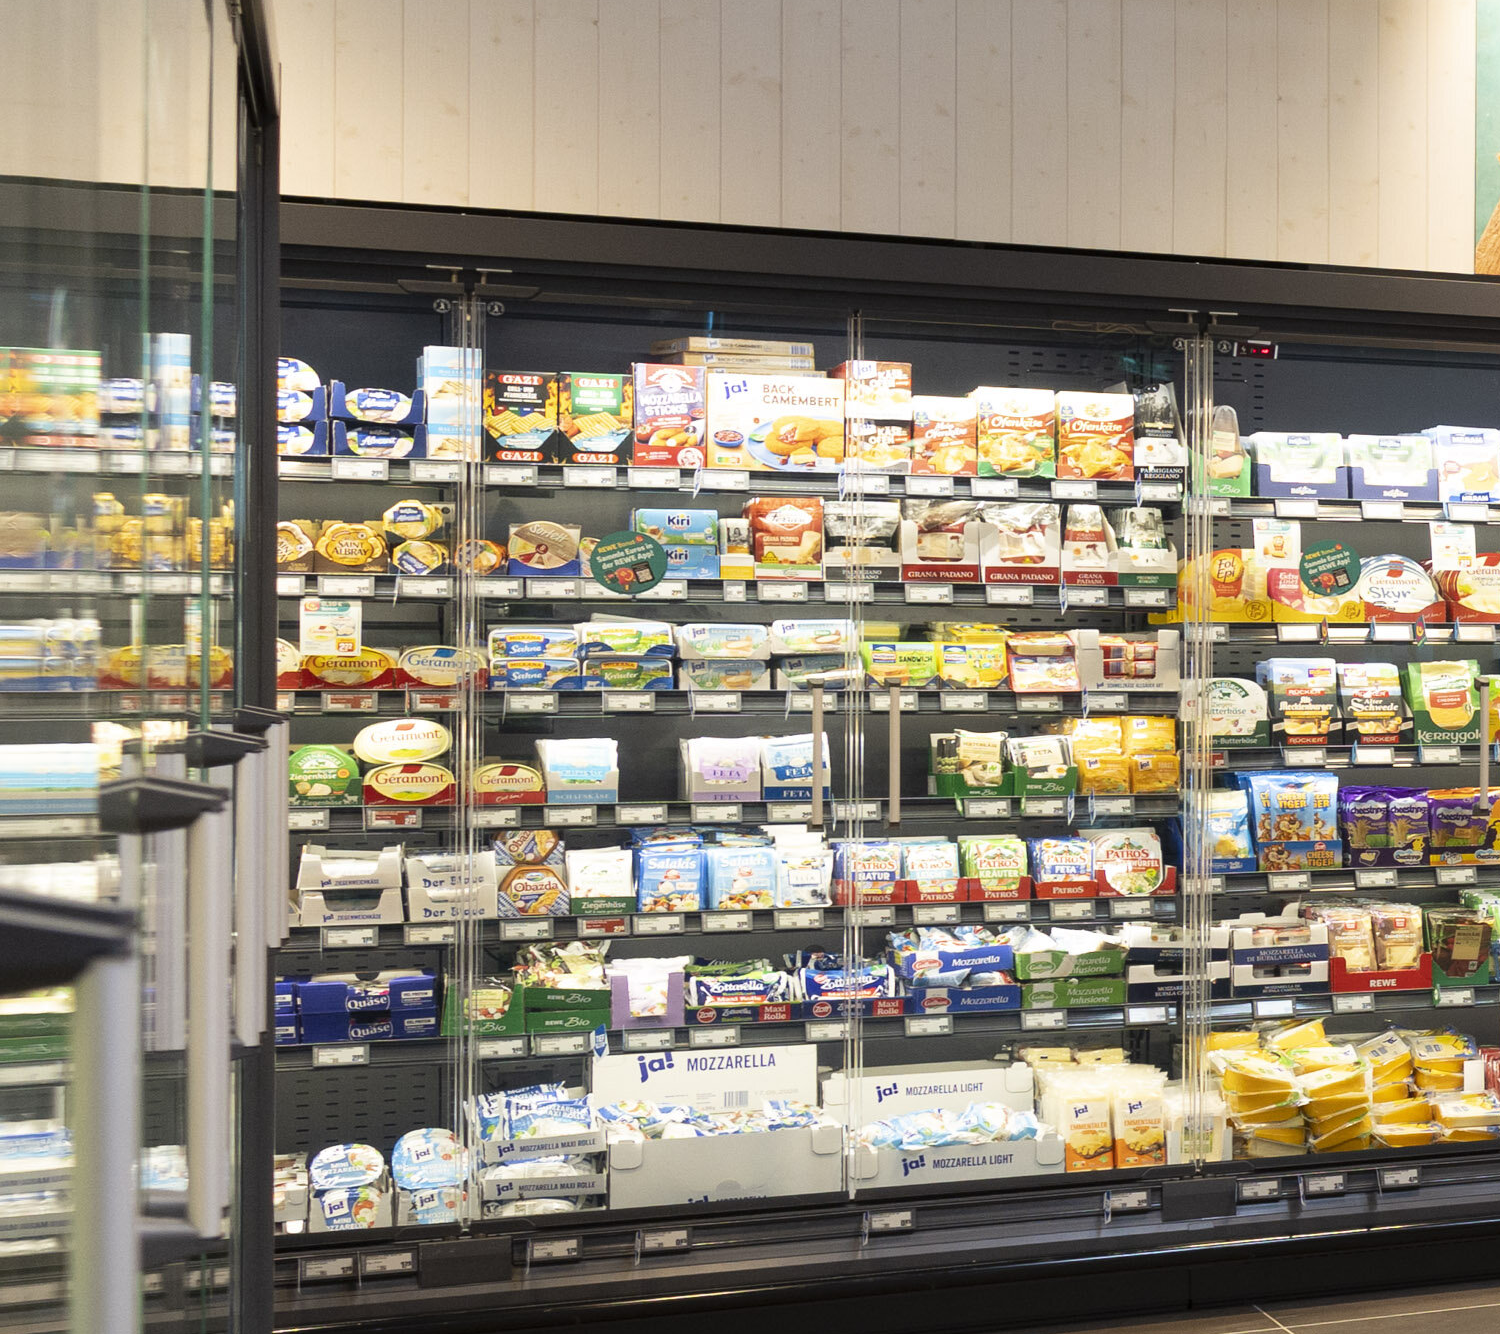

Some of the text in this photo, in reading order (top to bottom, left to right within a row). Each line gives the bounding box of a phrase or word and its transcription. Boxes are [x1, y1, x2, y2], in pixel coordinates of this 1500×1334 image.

[723, 379, 748, 401] ja!
[762, 383, 795, 395] BACK
[762, 396, 840, 407] CAMEMBERT
[667, 514, 691, 528] Kiri
[338, 540, 366, 549] SAINT
[332, 547, 370, 557] ALBRAY
[665, 547, 689, 560] Kiri
[939, 571, 973, 579] PADANO
[1368, 586, 1411, 601] Skyr
[312, 656, 385, 671] Géramont
[375, 771, 447, 787] Géramont
[479, 774, 536, 789] Géramont
[784, 789, 812, 798] FETA
[647, 857, 702, 870] Salakis
[513, 879, 558, 893] Obazda
[951, 954, 1000, 966] Mozzarella
[1370, 979, 1397, 988] REWE
[346, 997, 388, 1011] Quäse
[959, 994, 1009, 1004] Mozzarella
[764, 1012, 786, 1020] Rolle
[638, 1052, 776, 1082] ja! MOZZARELLA
[498, 1142, 515, 1157] ja!
[519, 1143, 559, 1154] MOZZARELLA
[903, 1154, 1014, 1176] ja! MOZZARELLA LIGHT
[497, 1182, 514, 1196] ja!
[328, 1200, 345, 1216] ja!
